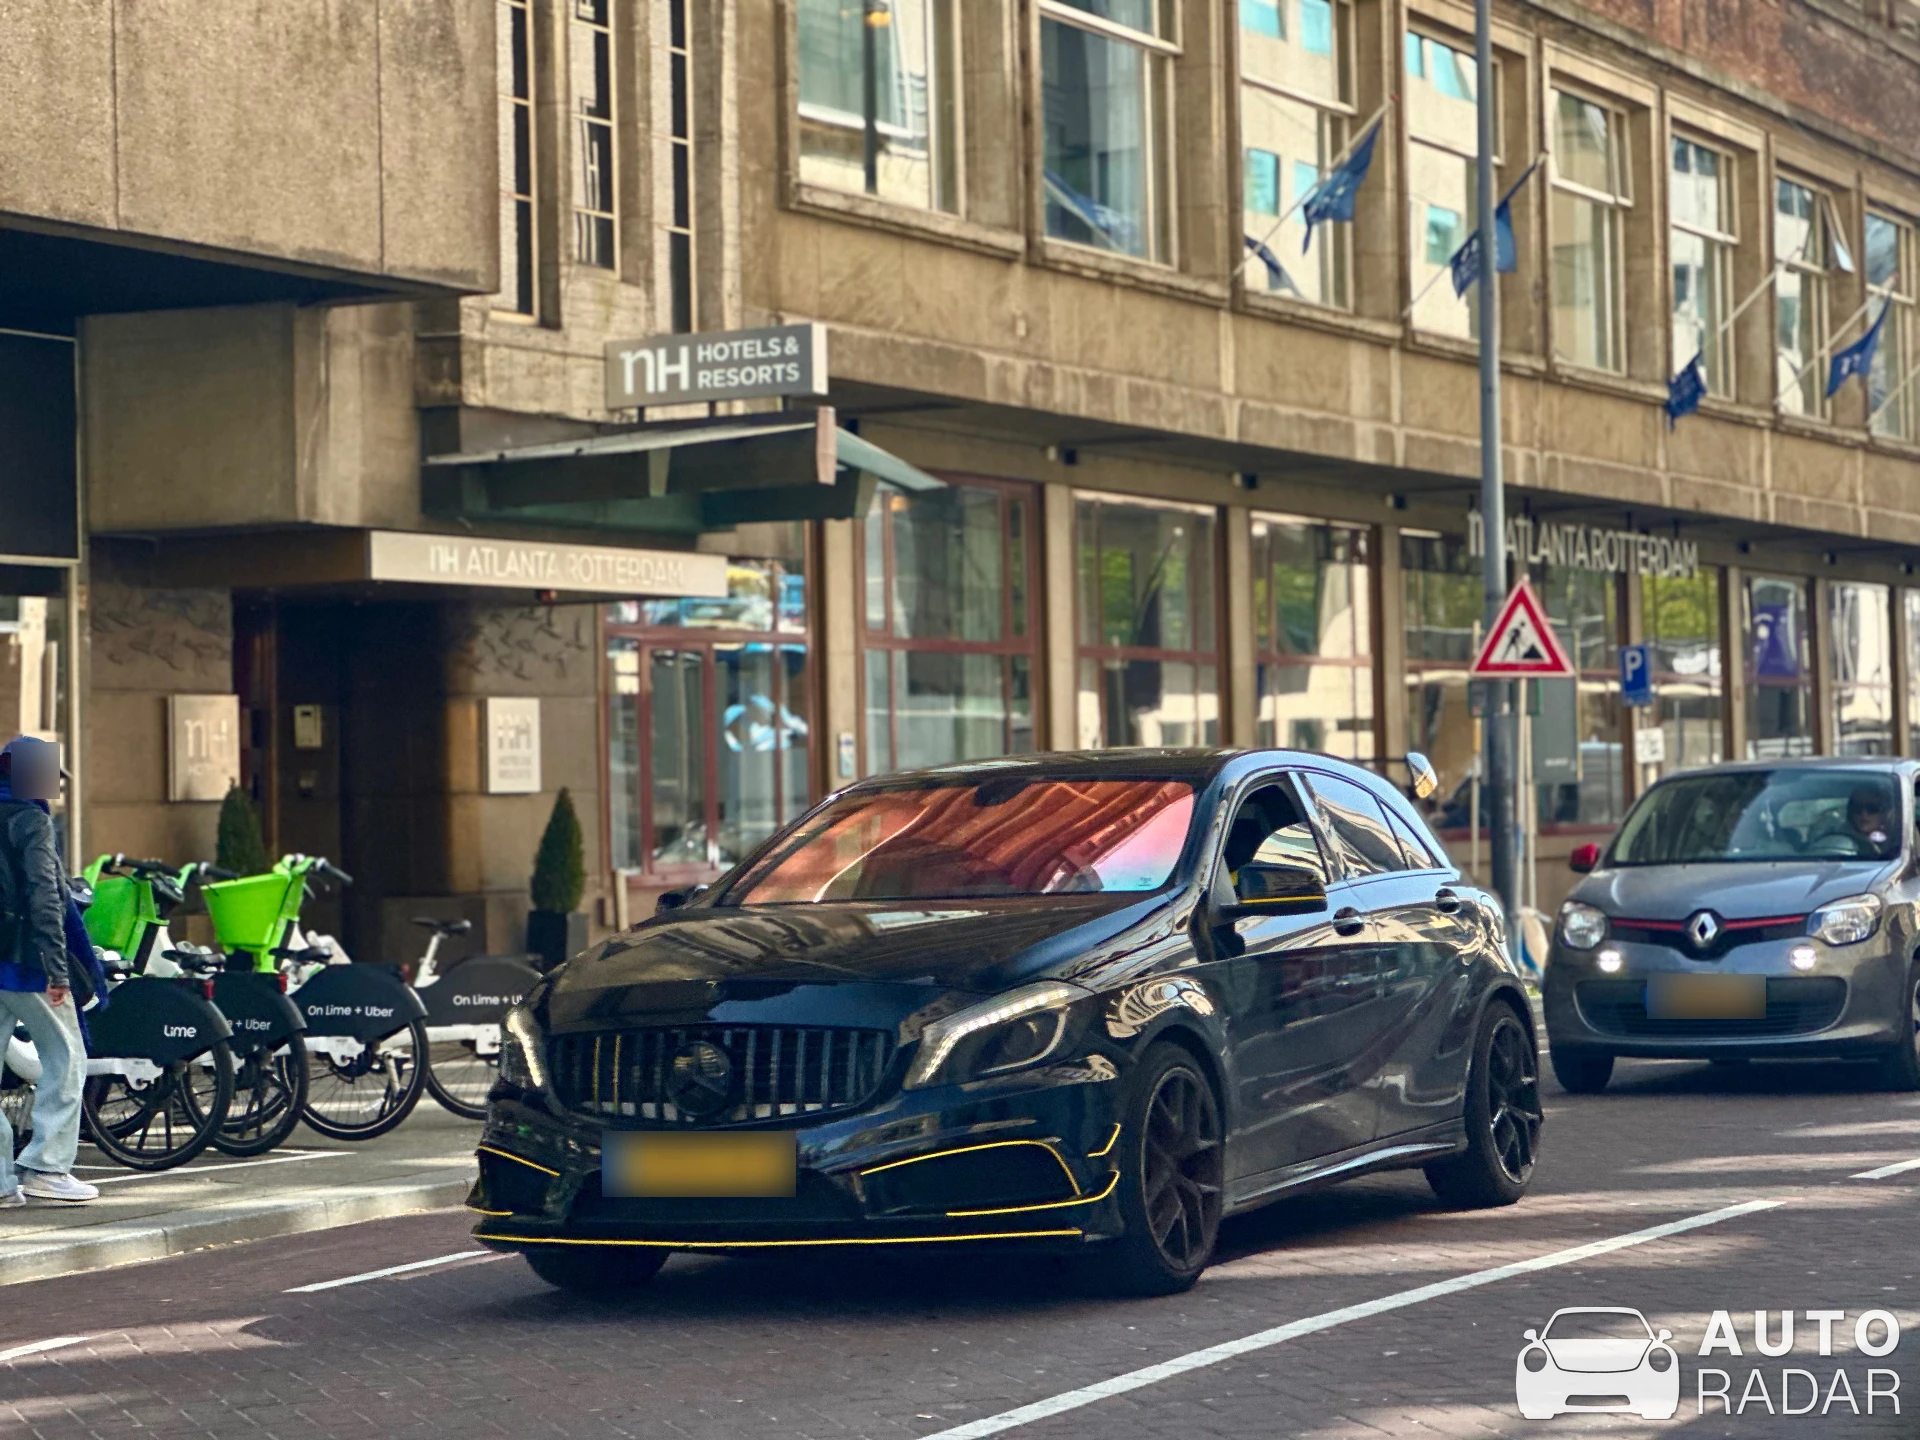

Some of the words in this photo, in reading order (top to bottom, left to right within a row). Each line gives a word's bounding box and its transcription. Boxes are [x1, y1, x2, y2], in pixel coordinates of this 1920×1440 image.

[697, 337, 782, 363] HOTELS
[697, 363, 800, 389] RESORTS
[1504, 516, 1590, 569] ATLANTA
[1591, 529, 1698, 578] ROTTERDAM
[466, 546, 558, 580] ATLANTA
[566, 552, 685, 587] ROTTERDAM
[1624, 649, 1643, 682] P
[307, 1005, 324, 1016] On
[325, 1005, 351, 1016] Lime
[354, 1006, 362, 1014] +
[364, 1005, 394, 1018] Uber
[452, 994, 471, 1006] On
[472, 993, 500, 1006] Lime
[163, 1024, 197, 1038] Lime
[245, 1018, 272, 1031] Uber
